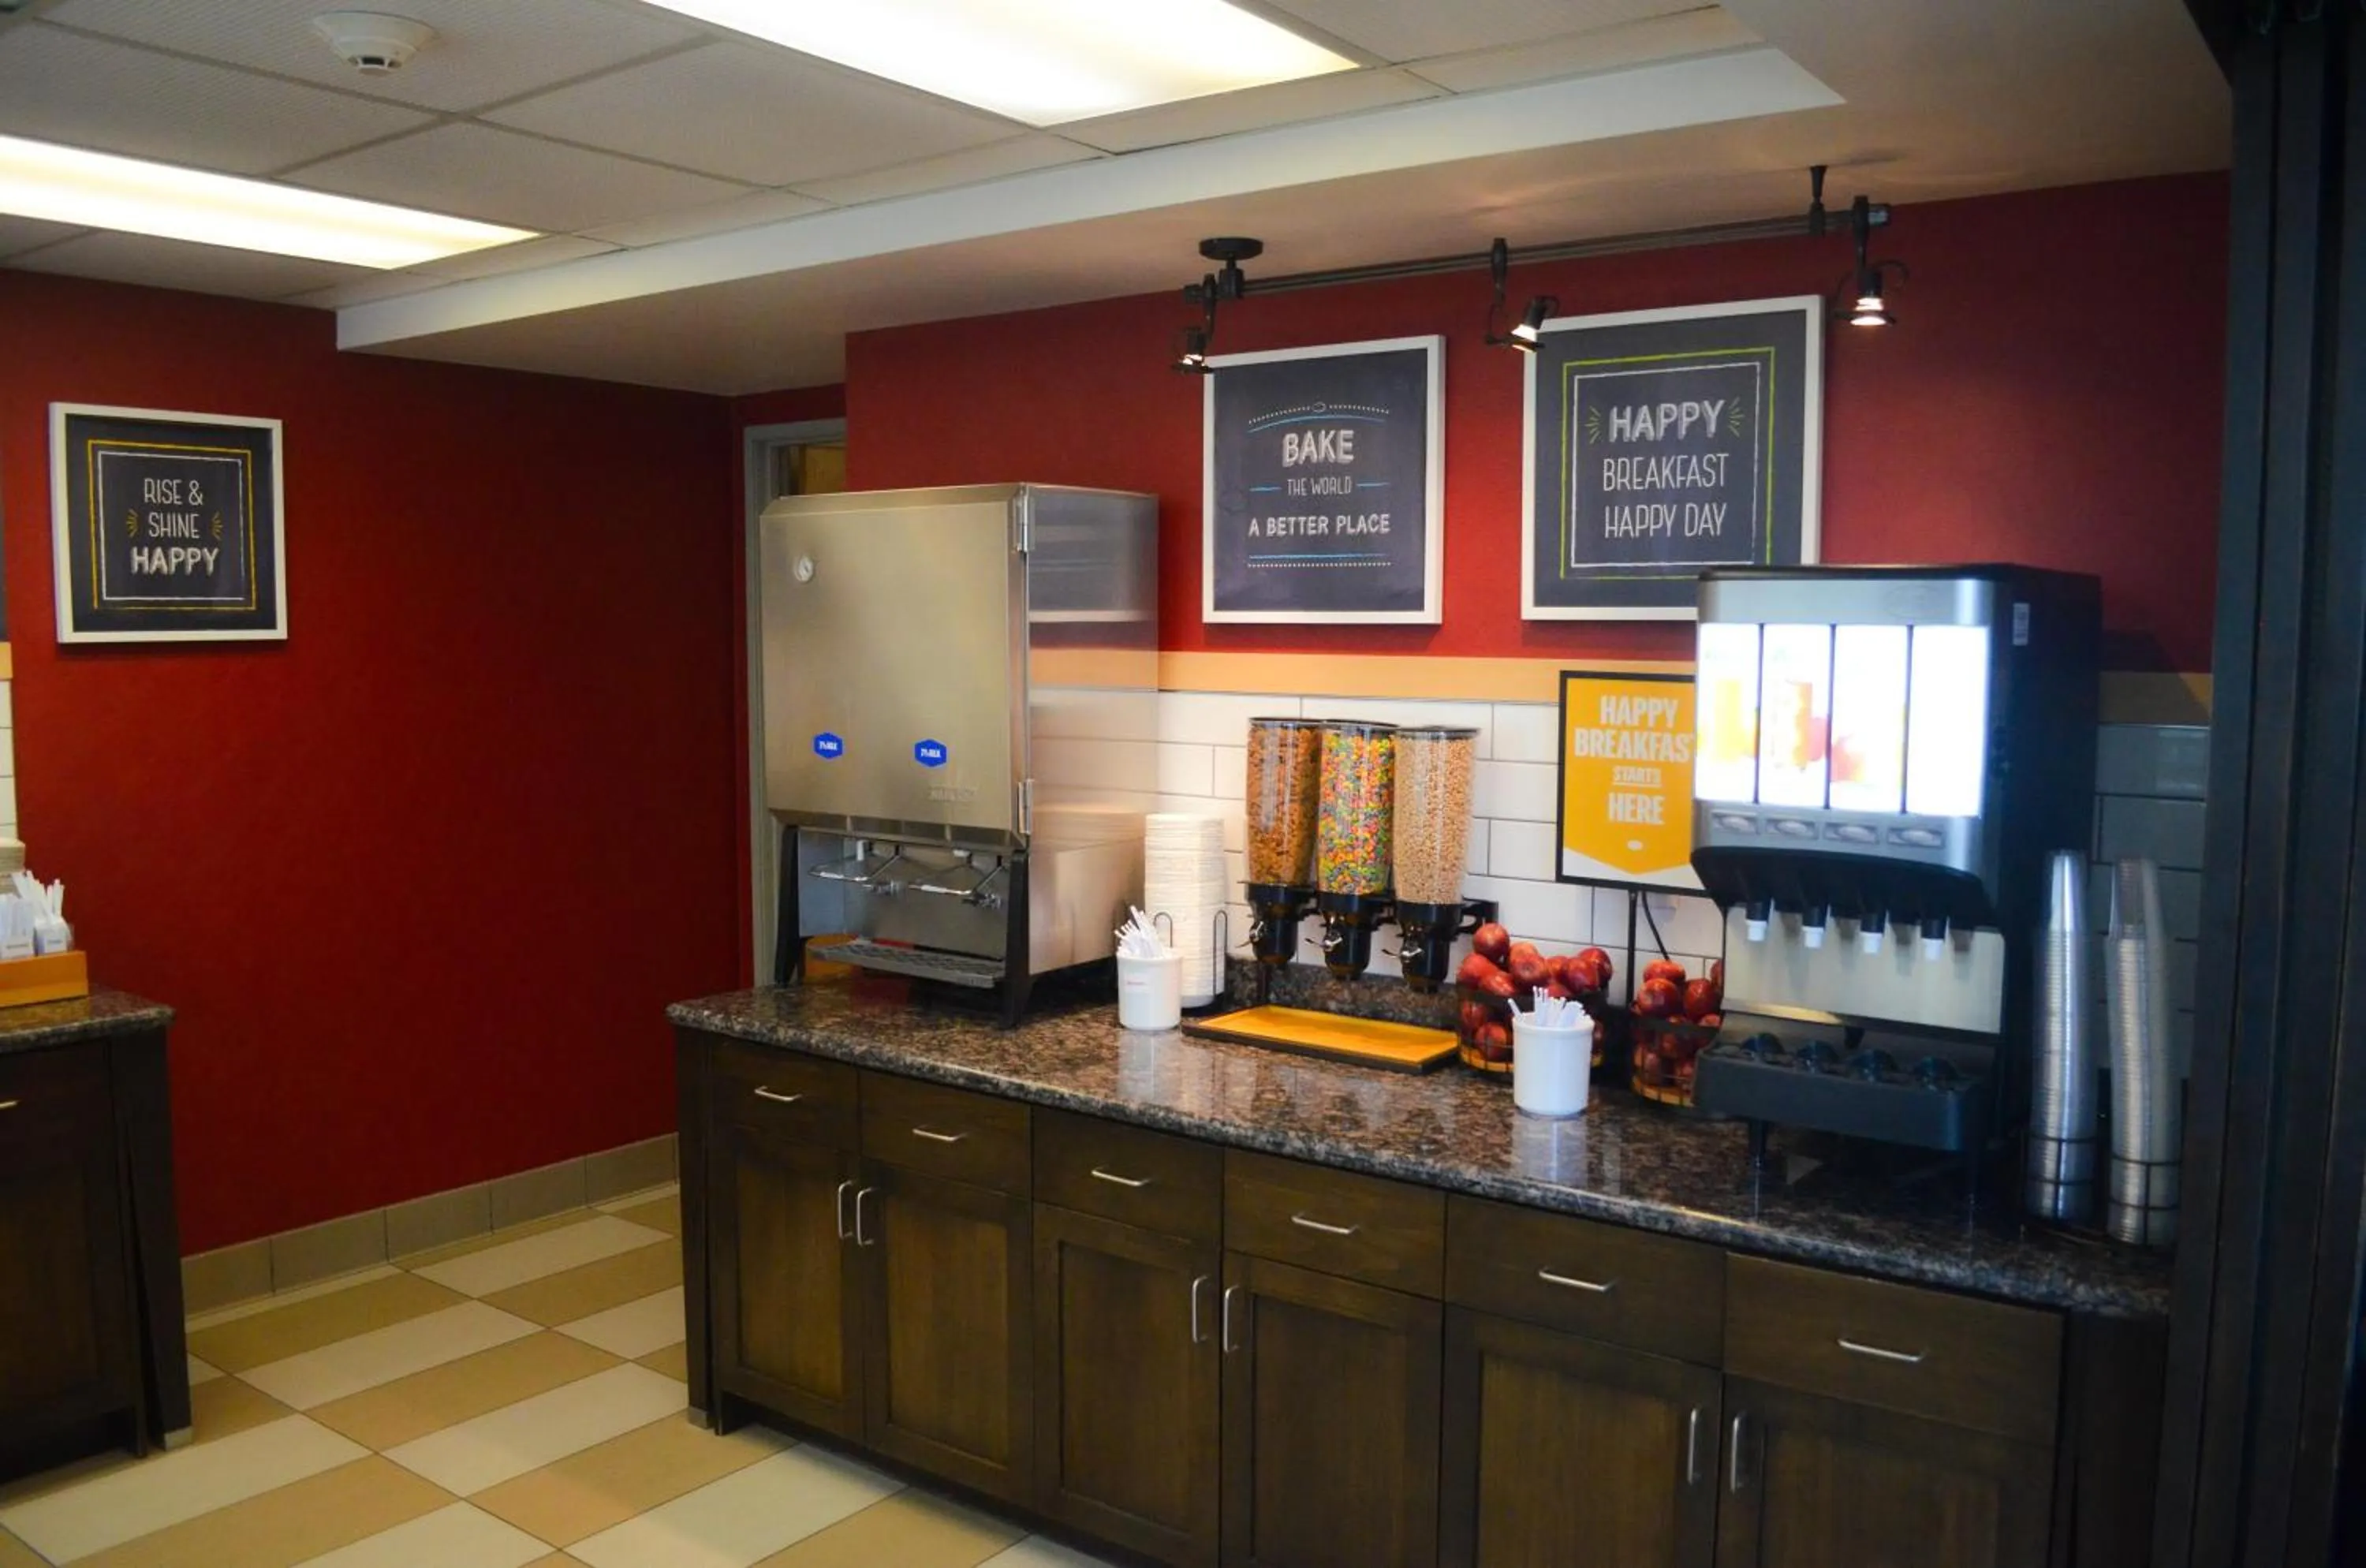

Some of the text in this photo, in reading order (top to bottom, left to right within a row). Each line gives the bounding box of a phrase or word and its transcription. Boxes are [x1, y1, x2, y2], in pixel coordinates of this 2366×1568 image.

[1609, 399, 1726, 442] HAPPY
[1282, 430, 1354, 467] BAKE
[1287, 476, 1353, 496] THE WORLD
[1603, 453, 1729, 491] BREAKFAST
[144, 478, 203, 505] RISE &
[148, 512, 200, 538] SHINE
[1248, 513, 1391, 537] A BETTER PLACE
[1605, 502, 1726, 538] HAPPY DAY
[130, 546, 219, 576] HAPPY
[1600, 694, 1678, 728] HAPPY
[1574, 727, 1695, 763] BREAKFAS
[1609, 792, 1665, 824] HERE
